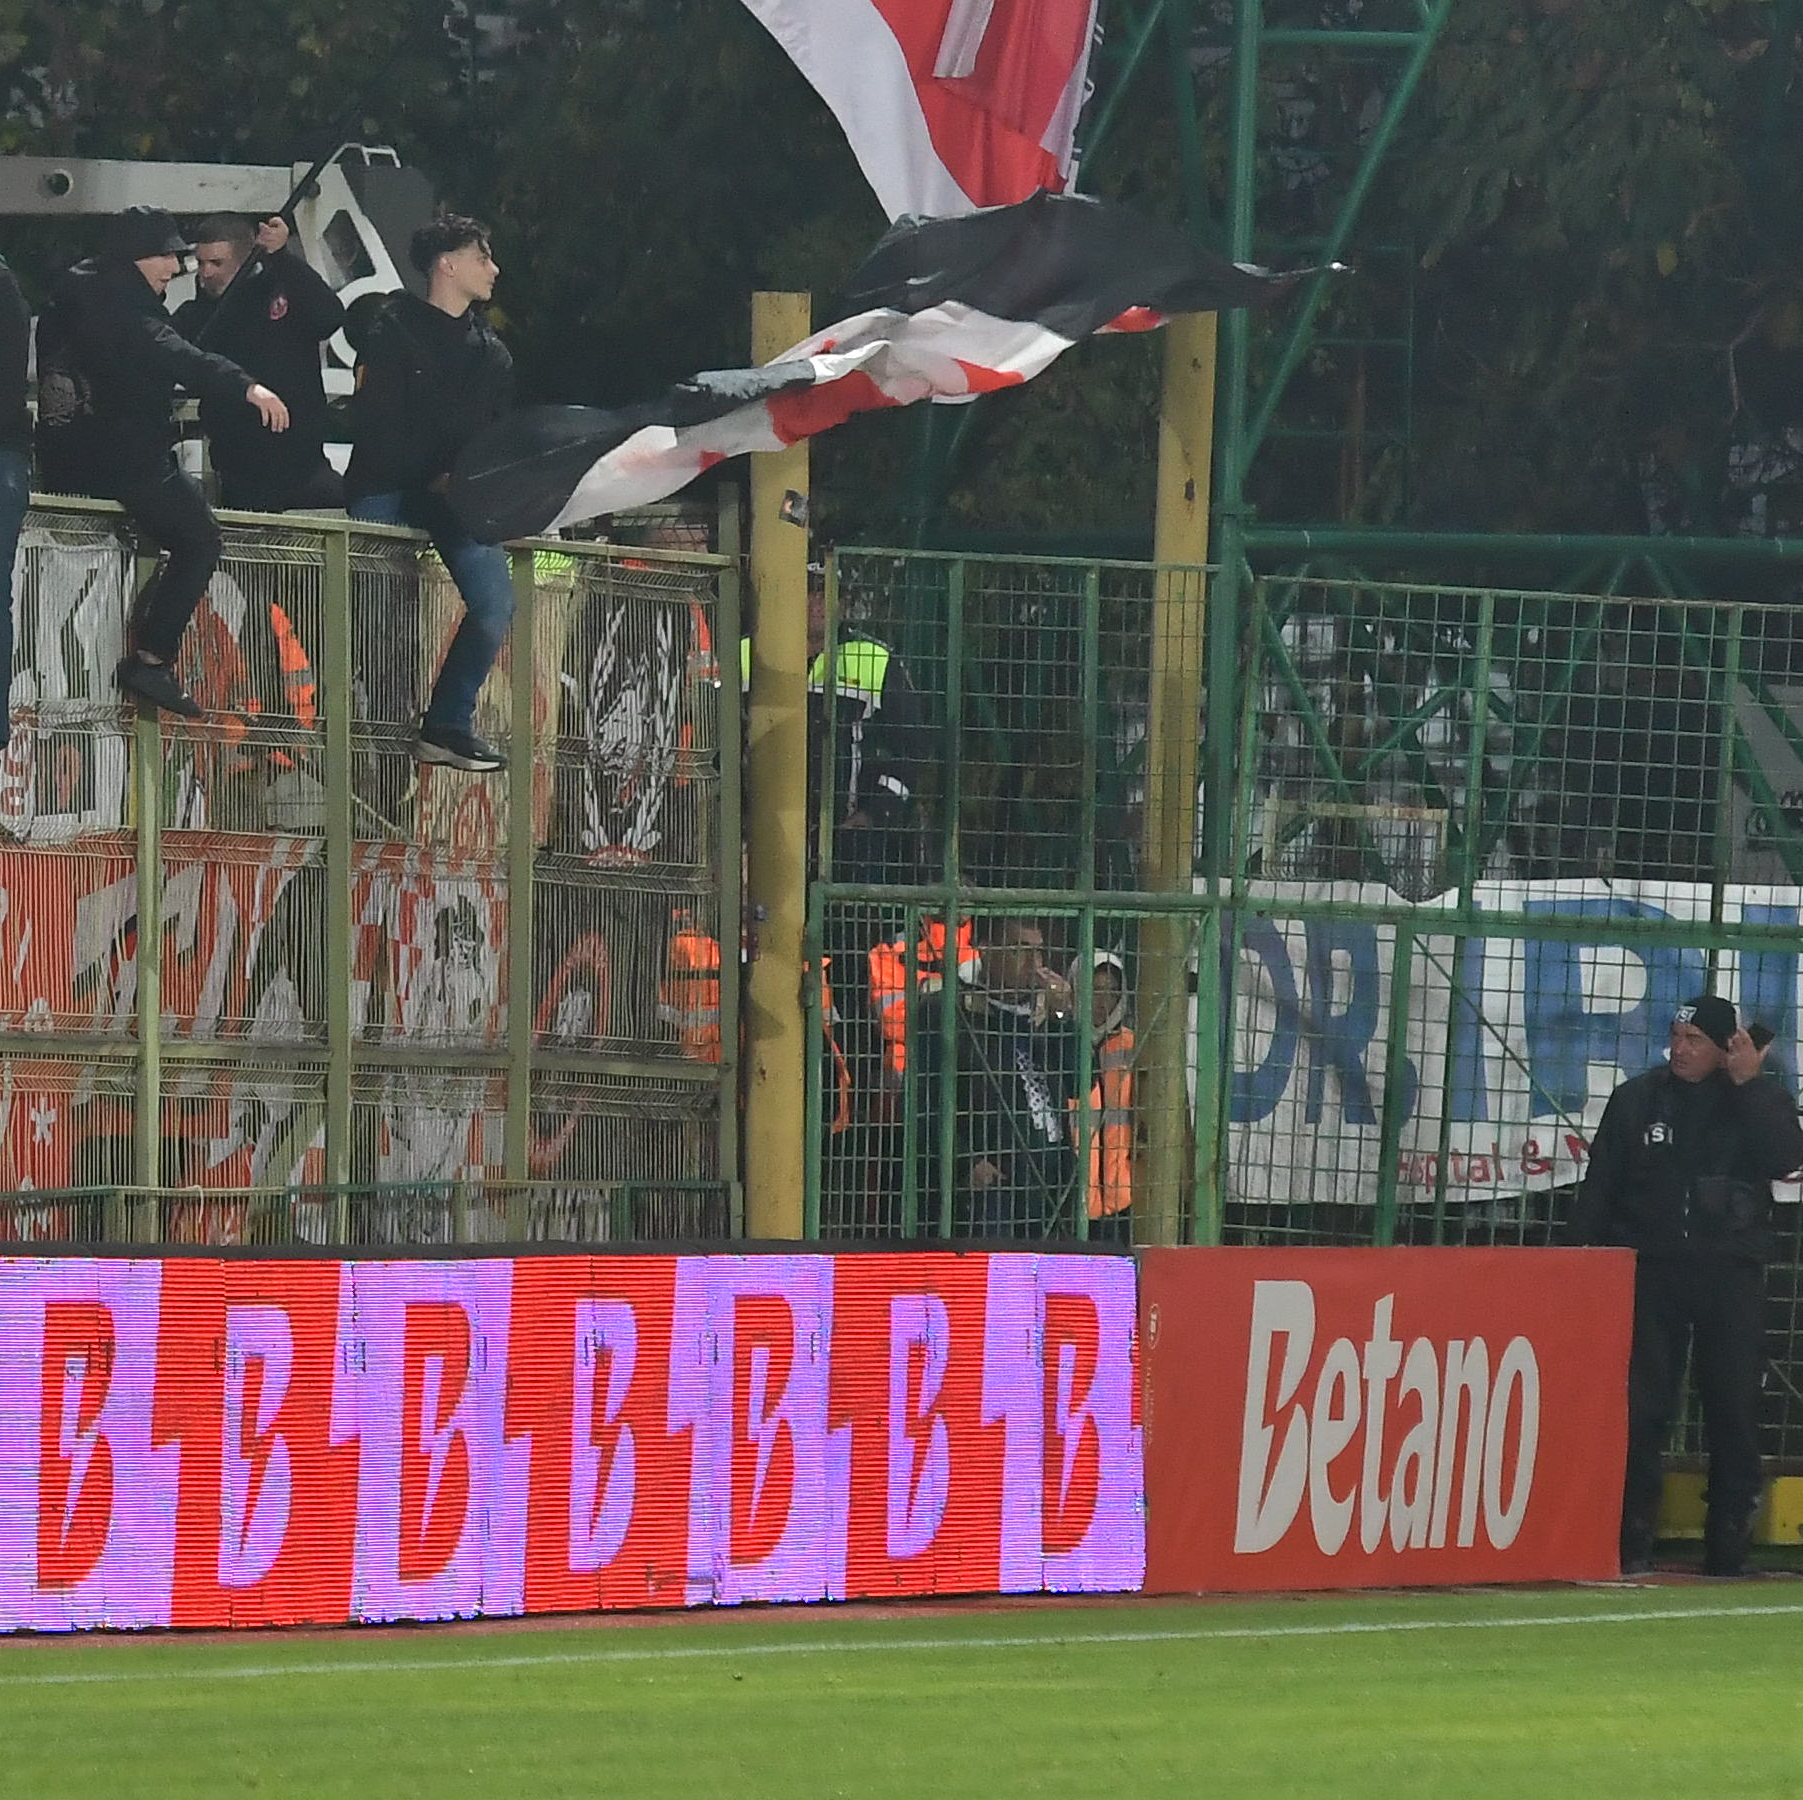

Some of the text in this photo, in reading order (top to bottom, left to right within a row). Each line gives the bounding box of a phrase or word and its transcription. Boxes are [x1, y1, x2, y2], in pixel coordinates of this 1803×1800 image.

[36, 1302, 116, 1589] B
[217, 1306, 294, 1589] B
[398, 1301, 472, 1580] B
[569, 1298, 638, 1571] B
[730, 1294, 797, 1564] B
[887, 1294, 950, 1559] B
[1043, 1294, 1101, 1554] B
[1233, 1280, 1539, 1556] Betano
